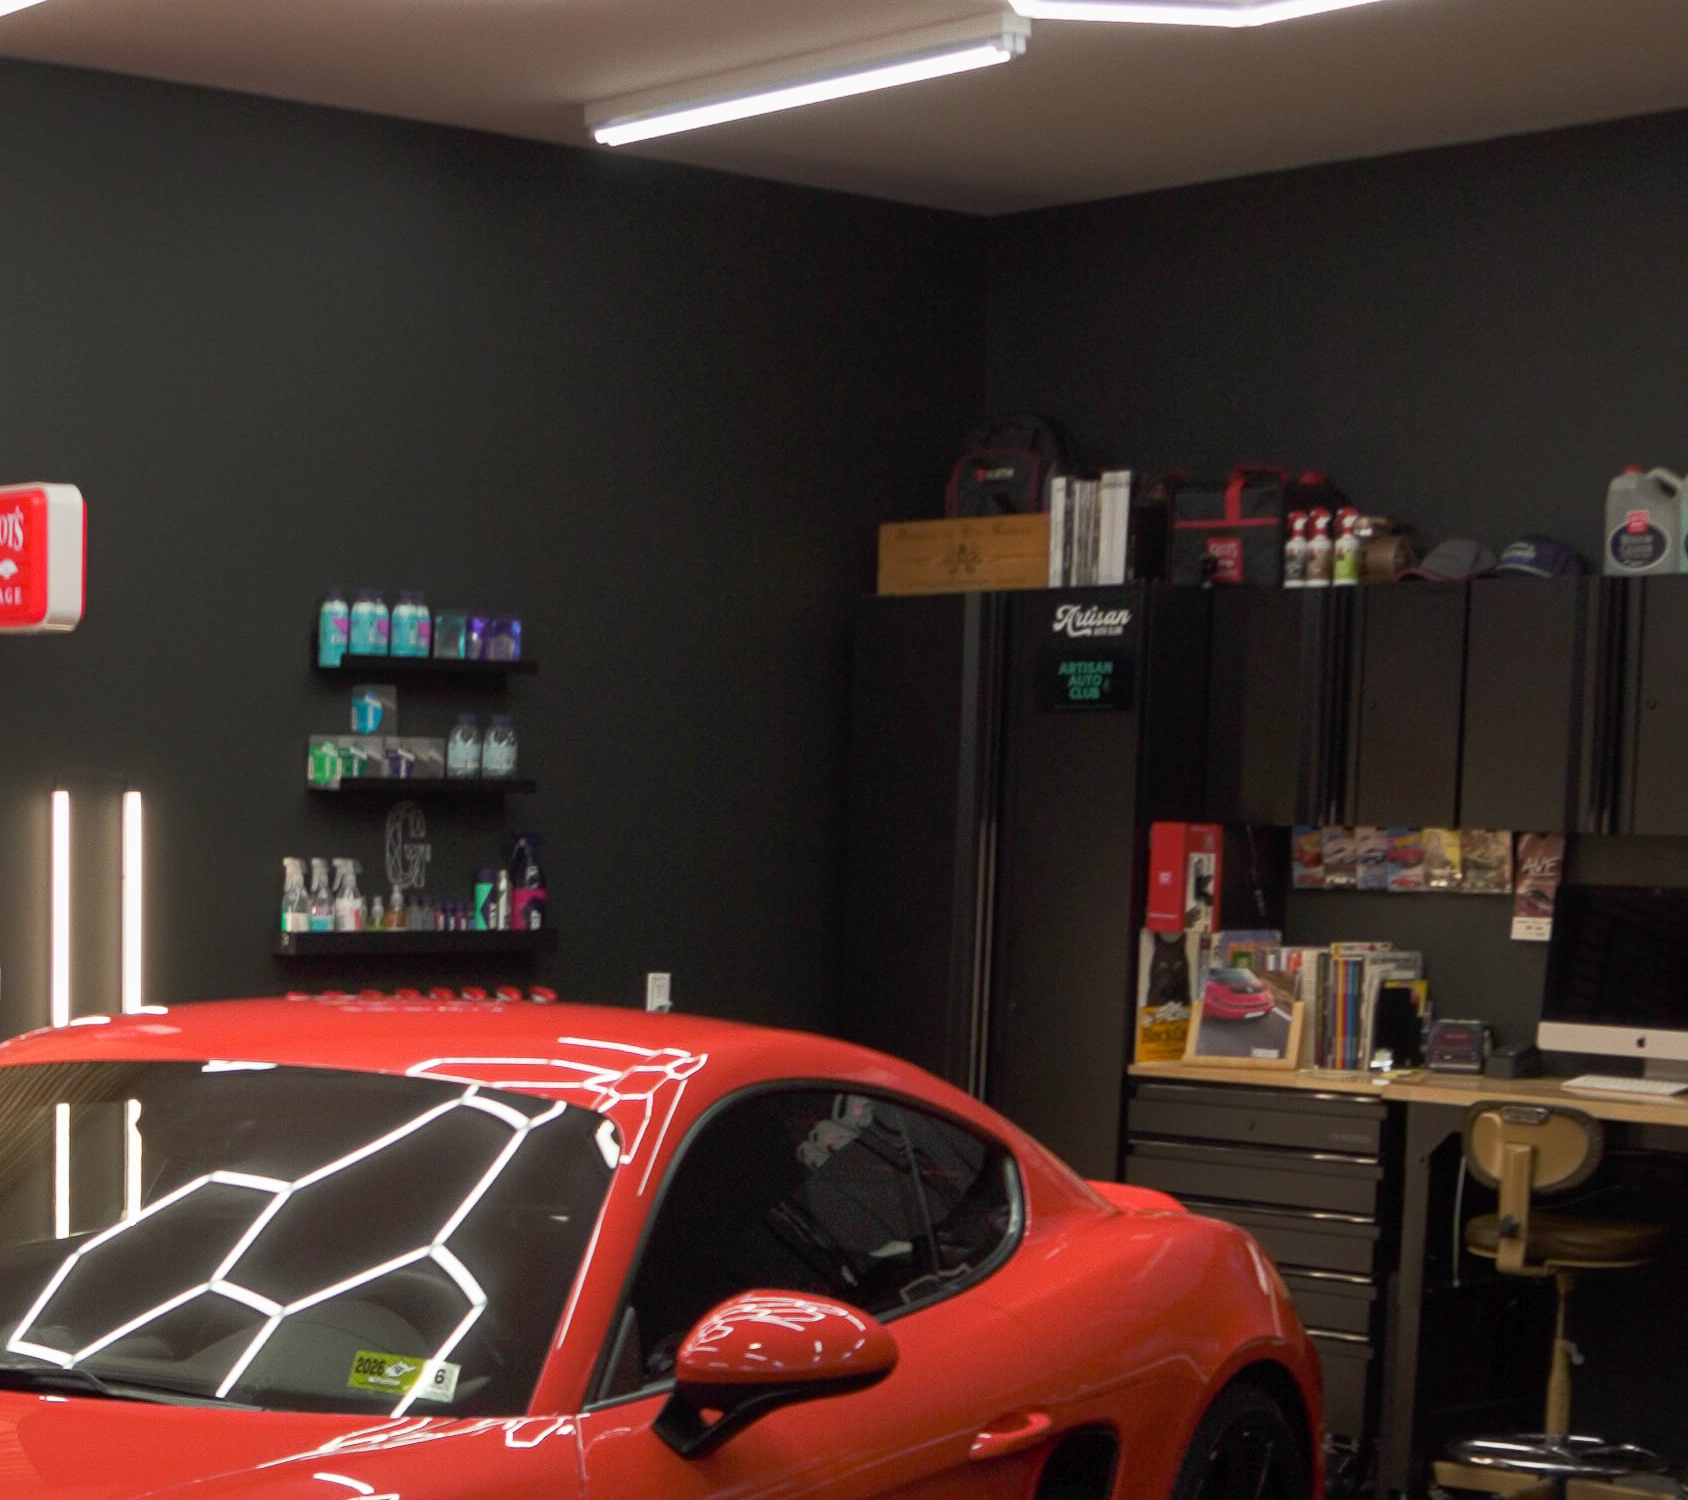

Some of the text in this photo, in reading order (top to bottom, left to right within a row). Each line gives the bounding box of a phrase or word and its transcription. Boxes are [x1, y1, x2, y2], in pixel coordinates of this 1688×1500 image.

[1053, 604, 1132, 638] Artisan
[1059, 661, 1113, 675] ARTISAN
[1067, 675, 1102, 687] AUTO
[1069, 687, 1100, 700] CLUB
[434, 1368, 446, 1385] 6
